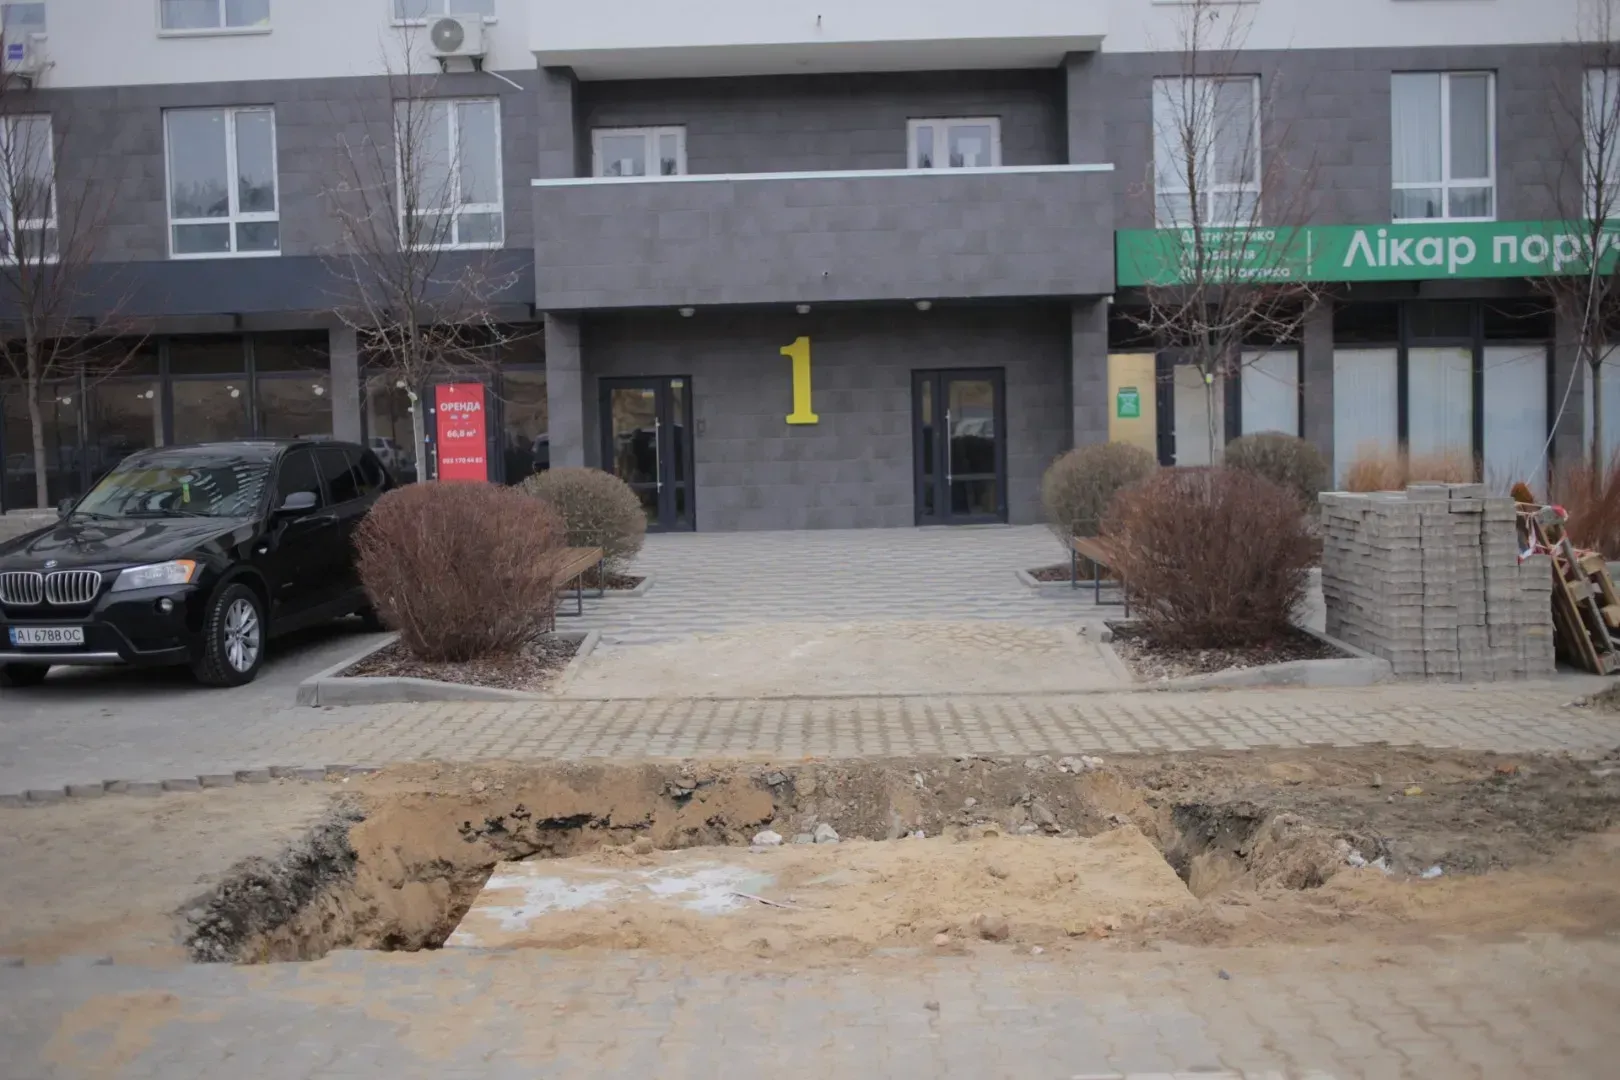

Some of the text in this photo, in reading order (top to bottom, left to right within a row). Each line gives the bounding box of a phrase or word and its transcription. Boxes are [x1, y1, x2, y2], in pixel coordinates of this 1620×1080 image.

[1342, 228, 1477, 274] Лікар
[780, 335, 819, 425] 1
[440, 402, 480, 412] ОРЕНДА
[34, 629, 62, 642] 6788
[63, 629, 81, 641] OC
